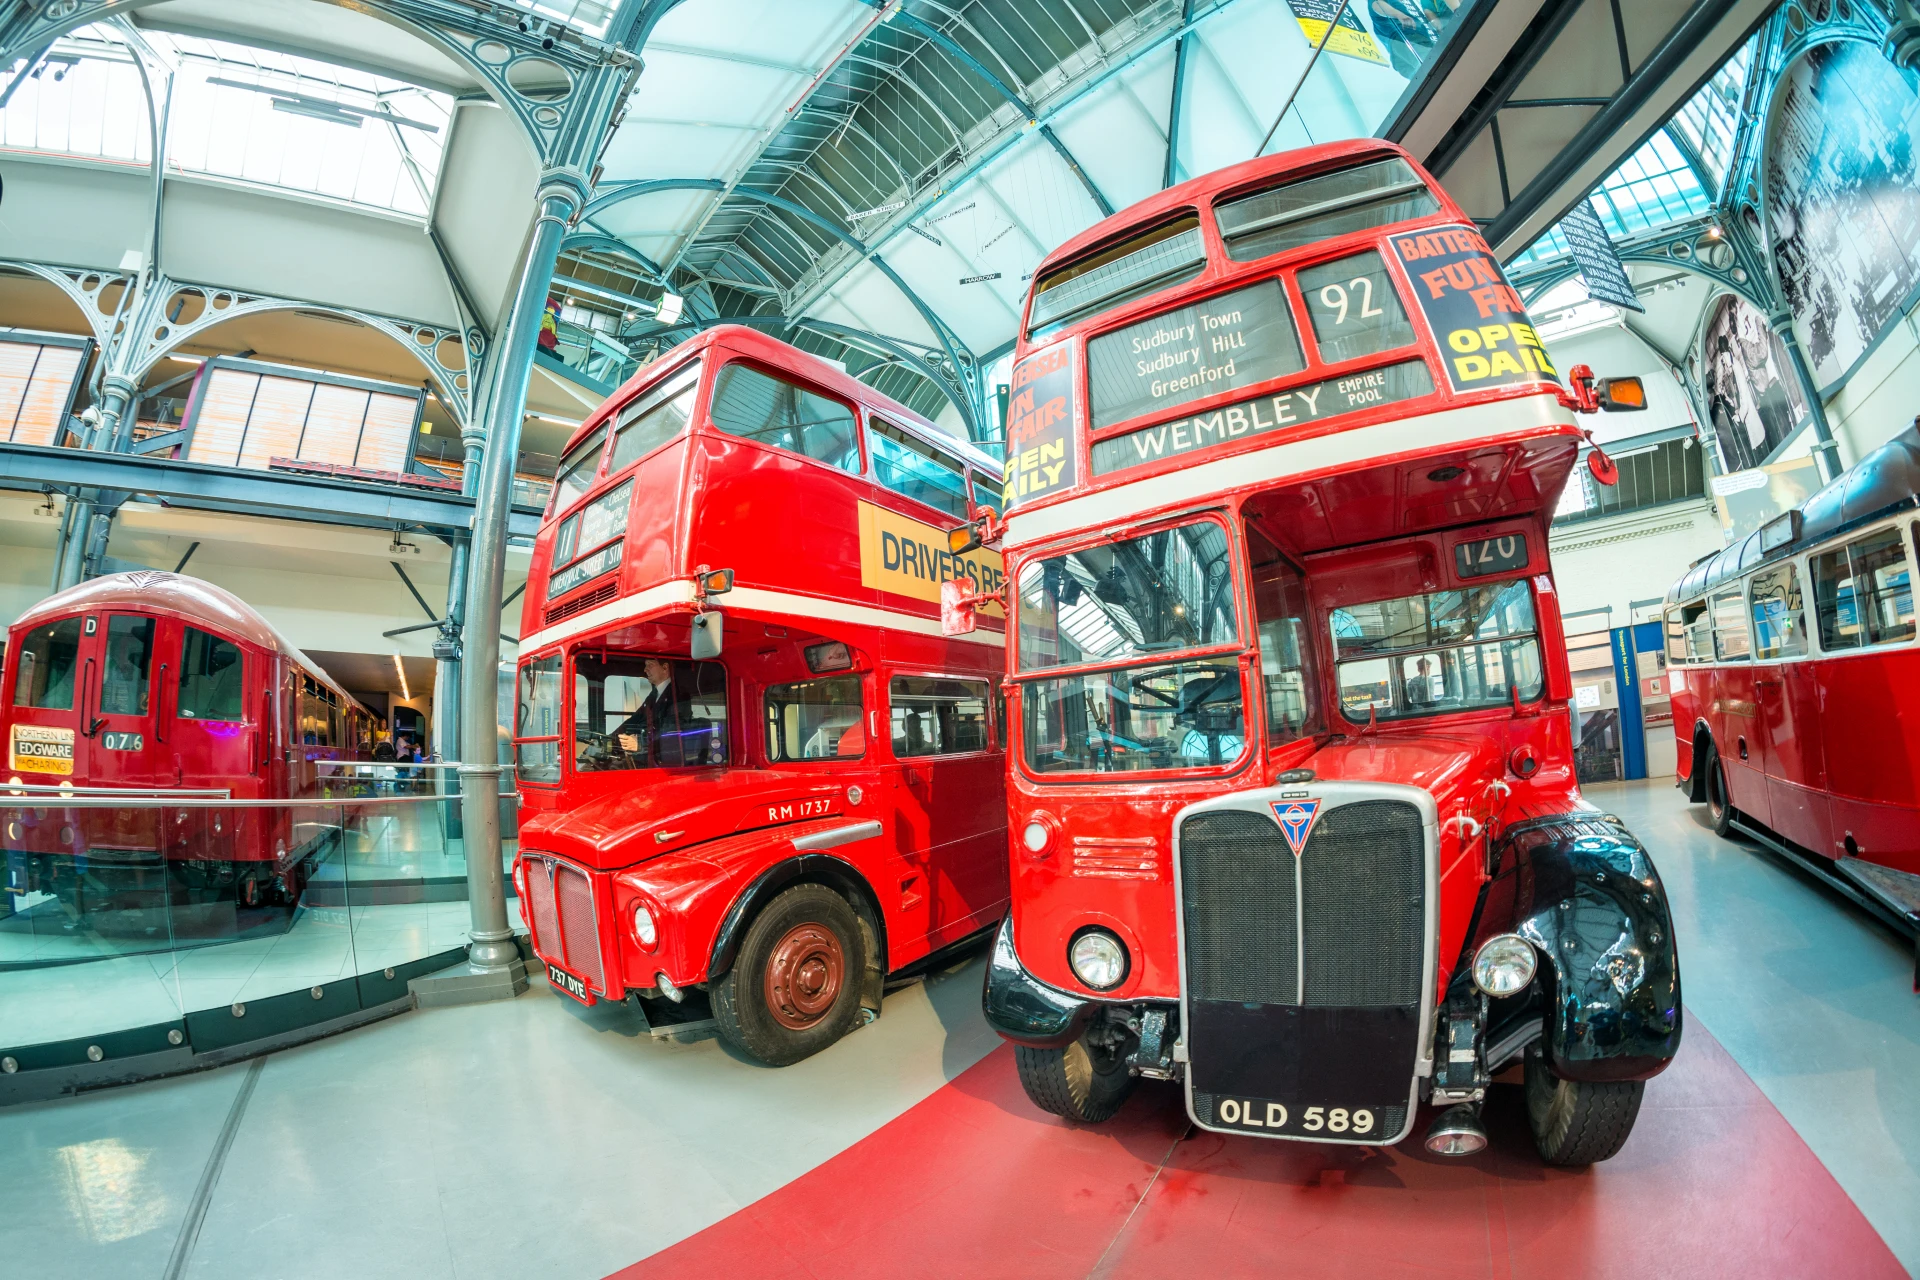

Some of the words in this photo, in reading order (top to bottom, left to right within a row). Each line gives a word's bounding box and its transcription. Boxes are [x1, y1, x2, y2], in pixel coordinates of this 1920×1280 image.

[850, 210, 872, 219] BAKER
[876, 203, 902, 213] STREET
[984, 226, 1013, 249] NEASDEN
[1566, 234, 1600, 250] TOOTING
[1569, 244, 1597, 259] TOOTING
[1575, 255, 1608, 270] TRAFALGAR
[1585, 266, 1627, 288] VAUXHALL
[965, 273, 996, 284] HARROW
[1419, 257, 1502, 300] FUN
[1320, 277, 1383, 325] 92
[1132, 323, 1195, 354] Sudbury
[1200, 310, 1242, 332] Town
[1137, 346, 1200, 377] Sudbury
[1211, 331, 1246, 354] Hill
[1453, 348, 1557, 382] DAIL
[1151, 358, 1236, 398] Greenford
[1337, 372, 1385, 395] EMPIRE
[1006, 387, 1035, 432] UN
[1347, 389, 1383, 406] POOL
[1007, 396, 1069, 454] FAIR
[1132, 387, 1322, 459] WEMBLEY
[1003, 437, 1065, 480] PEN
[608, 487, 631, 507] Chelsea
[1002, 459, 1067, 508] AILY
[560, 517, 576, 559] 11
[1463, 535, 1516, 566] 120
[550, 571, 580, 593] LIVERPOOL
[582, 550, 608, 577] STREET
[882, 530, 979, 593] DRIVERS
[85, 619, 97, 633] D
[1618, 629, 1626, 656] Transport
[15, 728, 58, 740] NORTHERN
[61, 731, 75, 741] LINE
[19, 742, 72, 757] EDGWARE
[26, 759, 67, 772] CHARING
[768, 805, 793, 821] RM
[800, 799, 831, 816] 1737
[549, 965, 566, 987] 737
[567, 975, 586, 1000] DYE
[1219, 1099, 1288, 1128] OLD
[1302, 1106, 1374, 1134] 589
